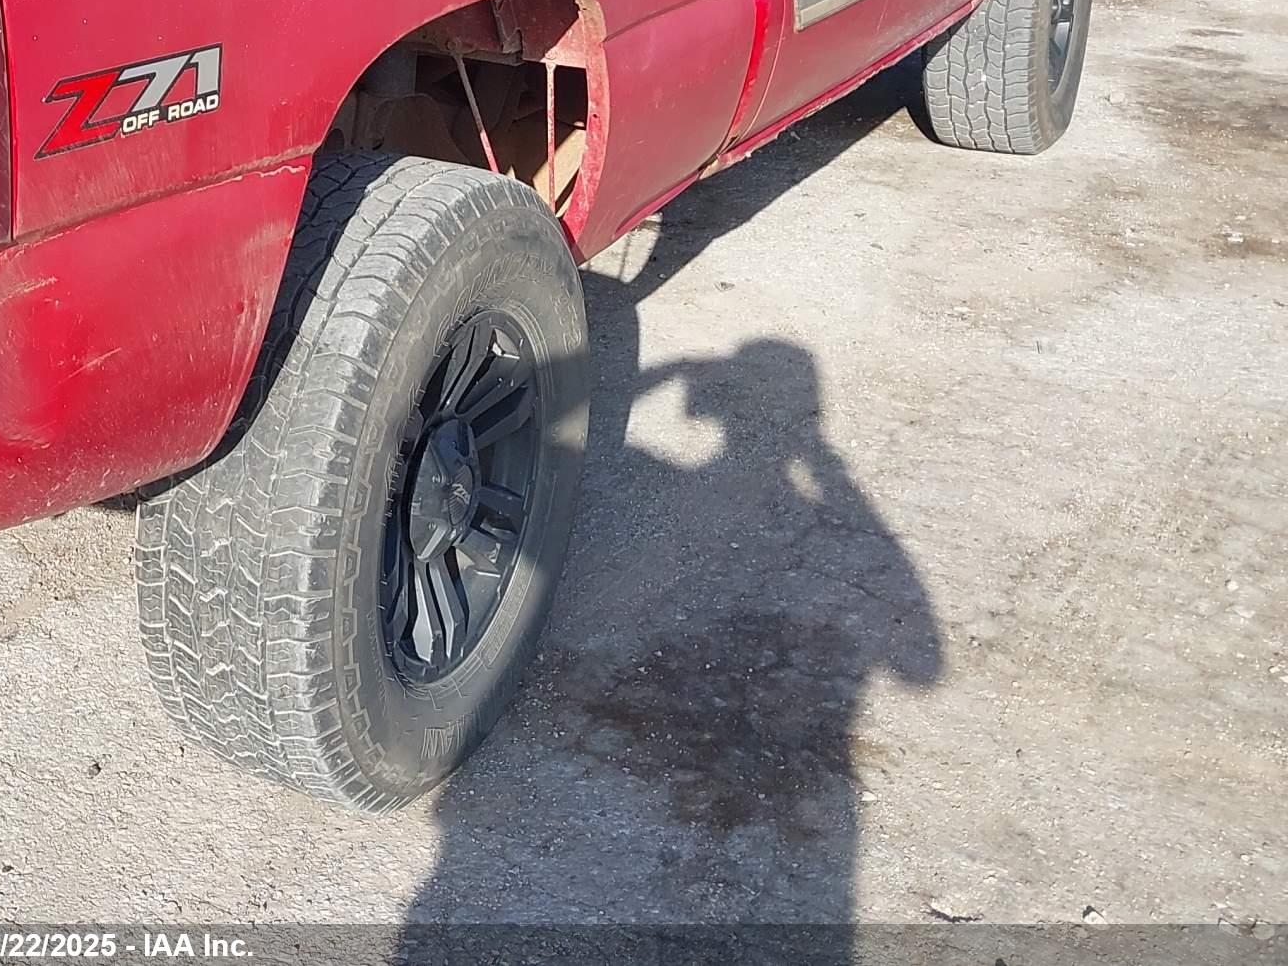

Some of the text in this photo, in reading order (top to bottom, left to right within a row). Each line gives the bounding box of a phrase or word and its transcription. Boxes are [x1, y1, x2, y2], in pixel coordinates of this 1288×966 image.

[34, 43, 223, 160] Z71
[121, 94, 219, 135] OFF ROAD
